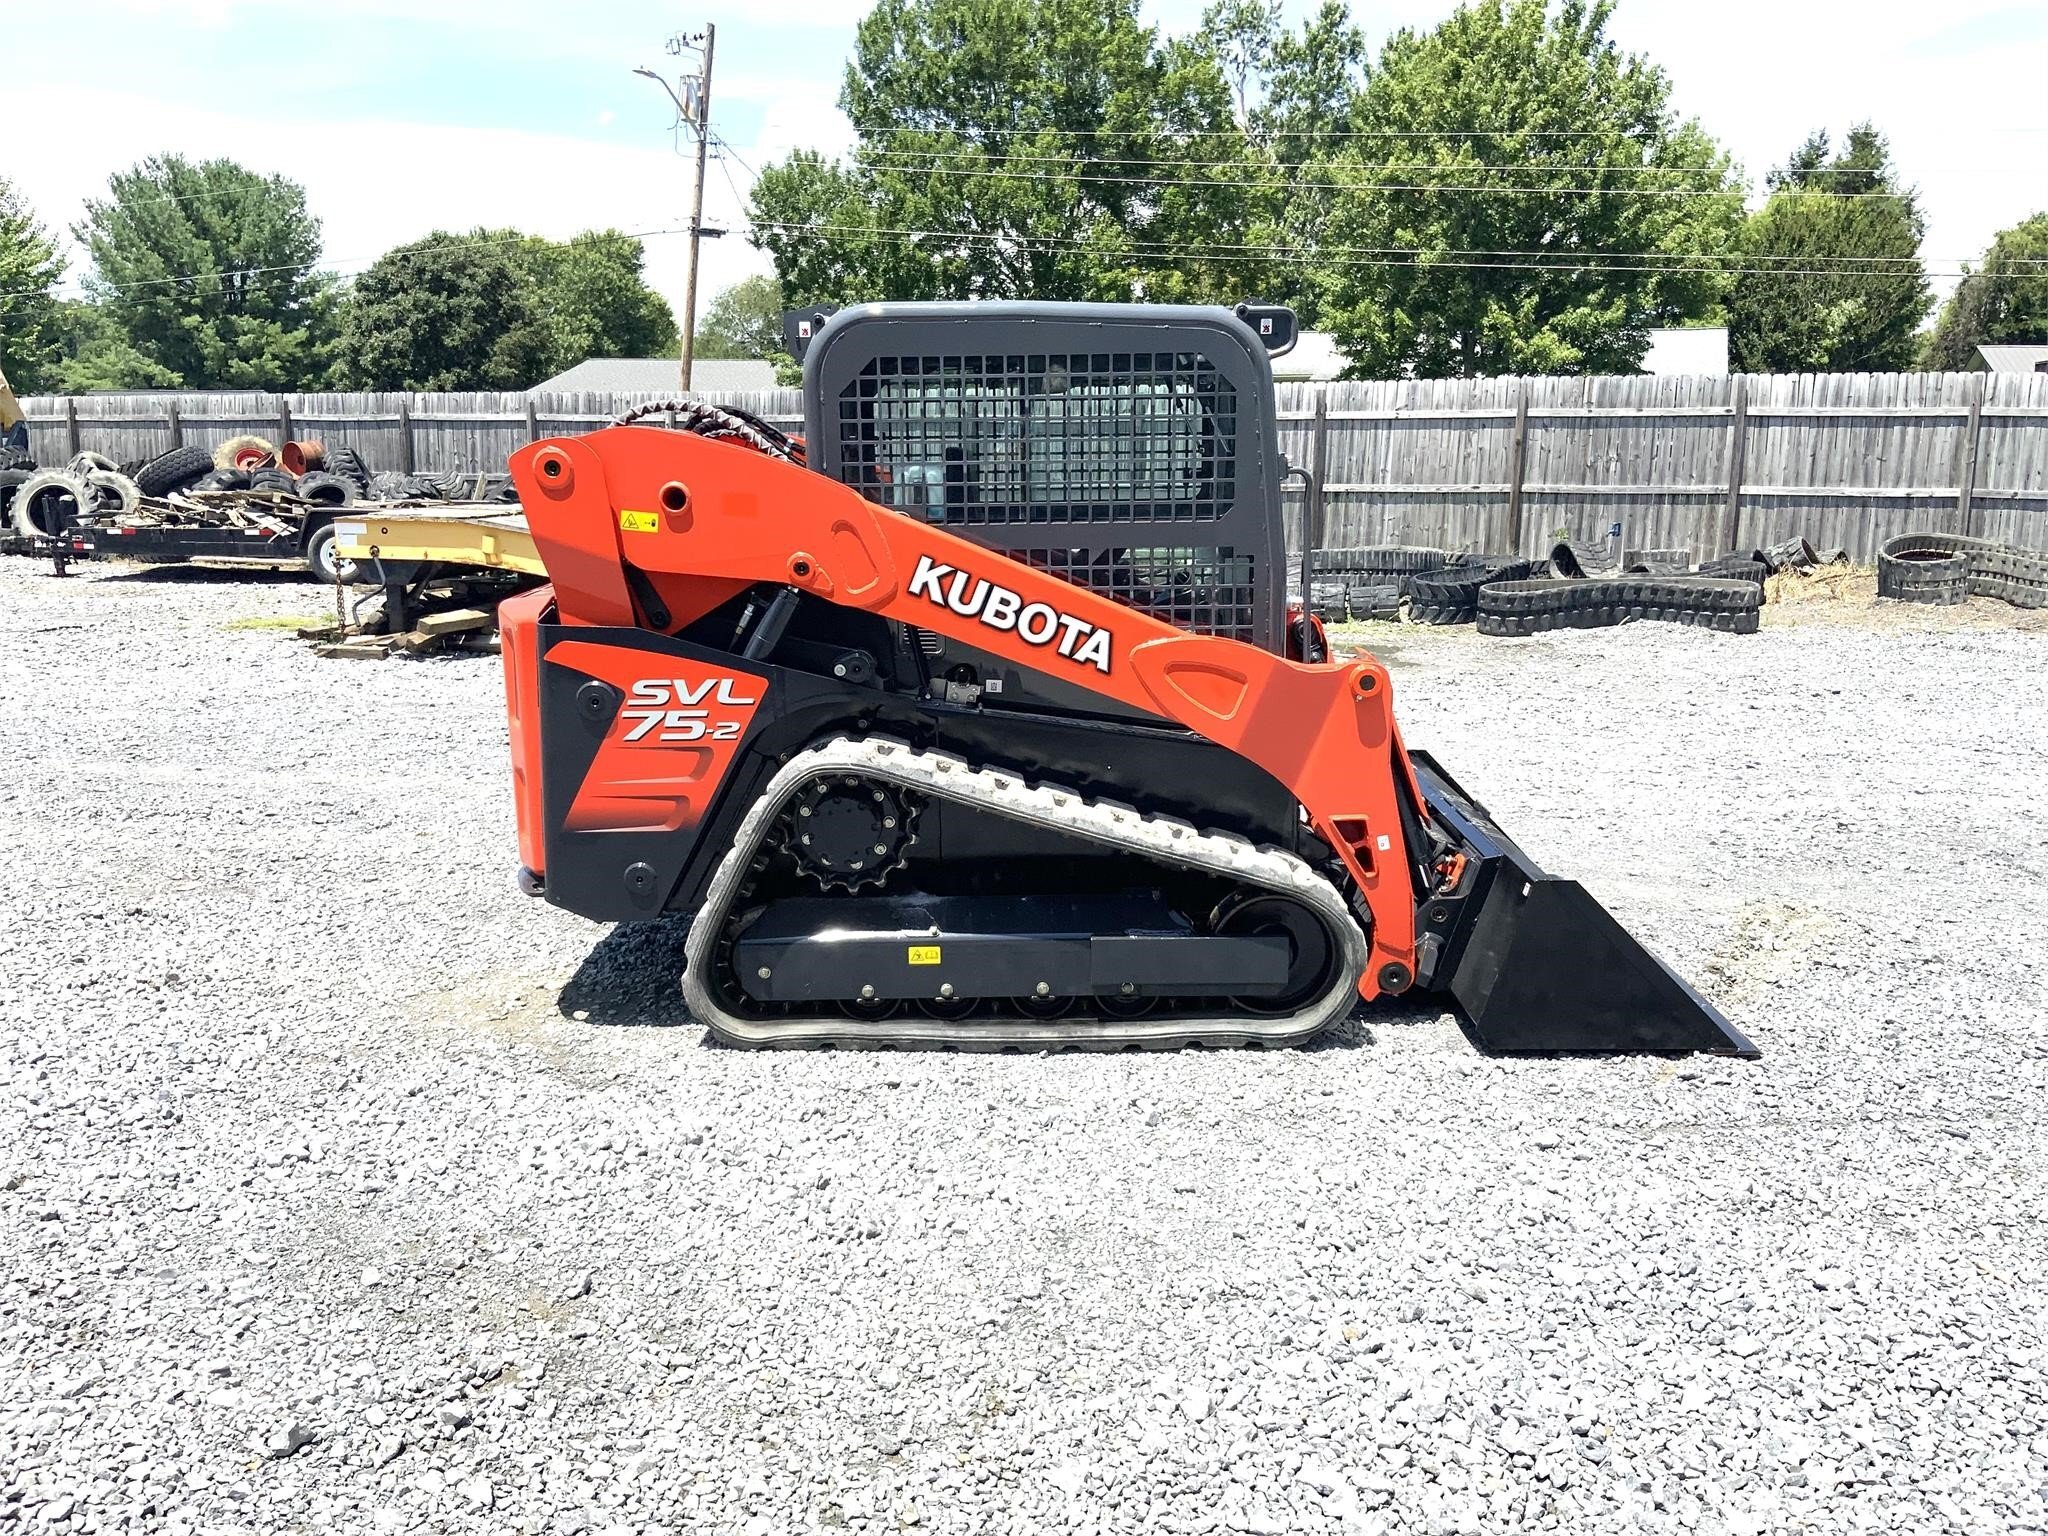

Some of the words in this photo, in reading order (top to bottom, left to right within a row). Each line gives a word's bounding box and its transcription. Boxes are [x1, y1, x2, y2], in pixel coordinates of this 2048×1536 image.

[907, 554, 1112, 673] KUBOTA
[626, 678, 756, 706] SVL
[621, 710, 741, 741] 75-2
